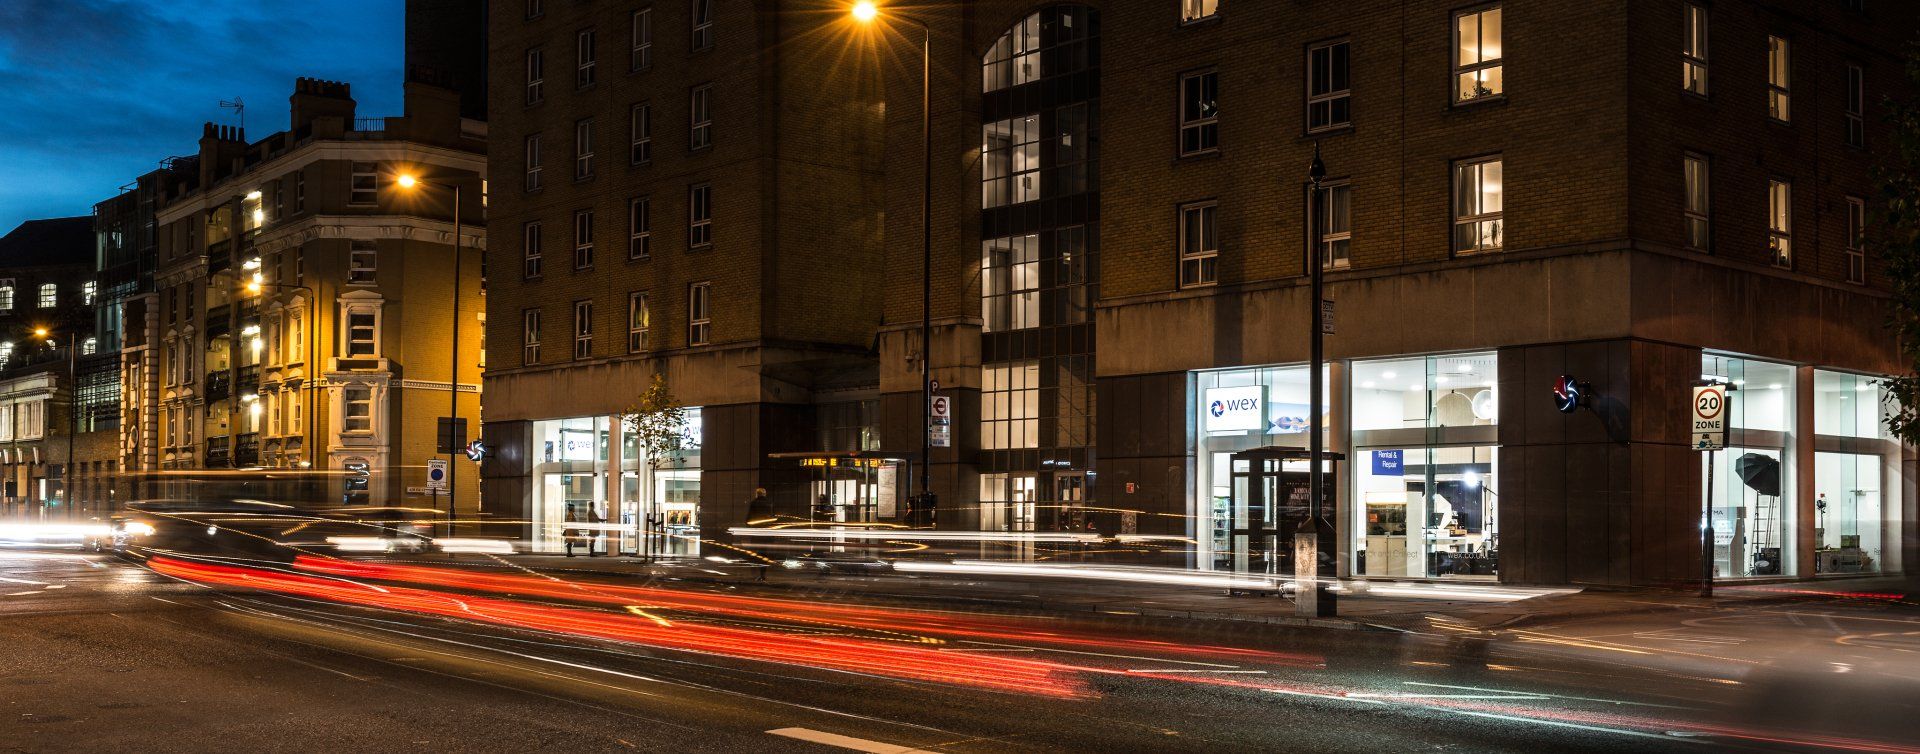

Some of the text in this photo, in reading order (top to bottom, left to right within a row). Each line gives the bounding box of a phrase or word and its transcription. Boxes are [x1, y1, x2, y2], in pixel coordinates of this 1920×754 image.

[932, 381, 938, 392] P
[1227, 398, 1258, 411] wex
[1700, 398, 1719, 410] 20
[1696, 421, 1721, 429] ZONE
[1379, 451, 1398, 459] Rental &
[1382, 460, 1398, 469] Repair
